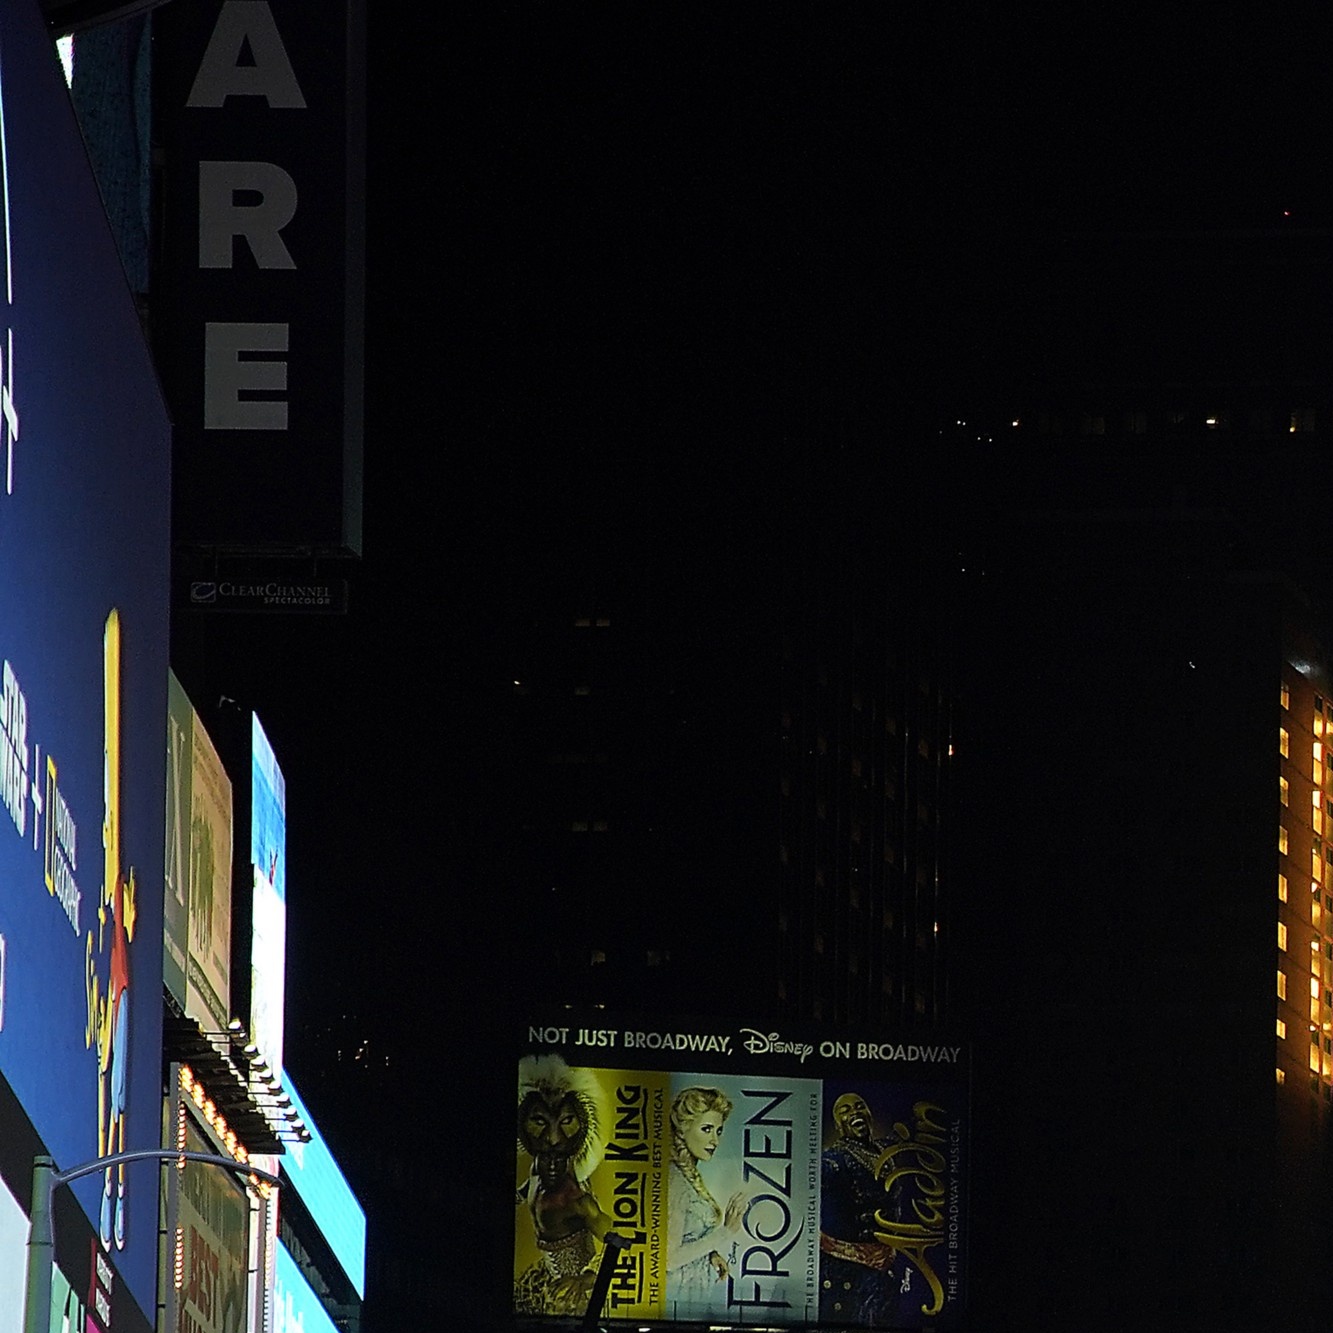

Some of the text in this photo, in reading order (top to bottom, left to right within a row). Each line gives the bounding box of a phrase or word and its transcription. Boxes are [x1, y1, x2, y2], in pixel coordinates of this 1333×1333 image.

[529, 1027, 961, 1064] NOT JUST BROADWAY, Disney ON BROADWAY
[605, 1085, 648, 1309] THE LION KING
[649, 1088, 664, 1306] THE AWARD-WINNING BEST MUSICAL
[727, 1089, 805, 1310] FROZEN
[806, 1195, 817, 1234] MUSICAL
[806, 1238, 817, 1287] BROADWAY
[873, 1101, 946, 1316] Aladdin
[947, 1119, 960, 1301] THE HIT BROADWAY MUSICAL
